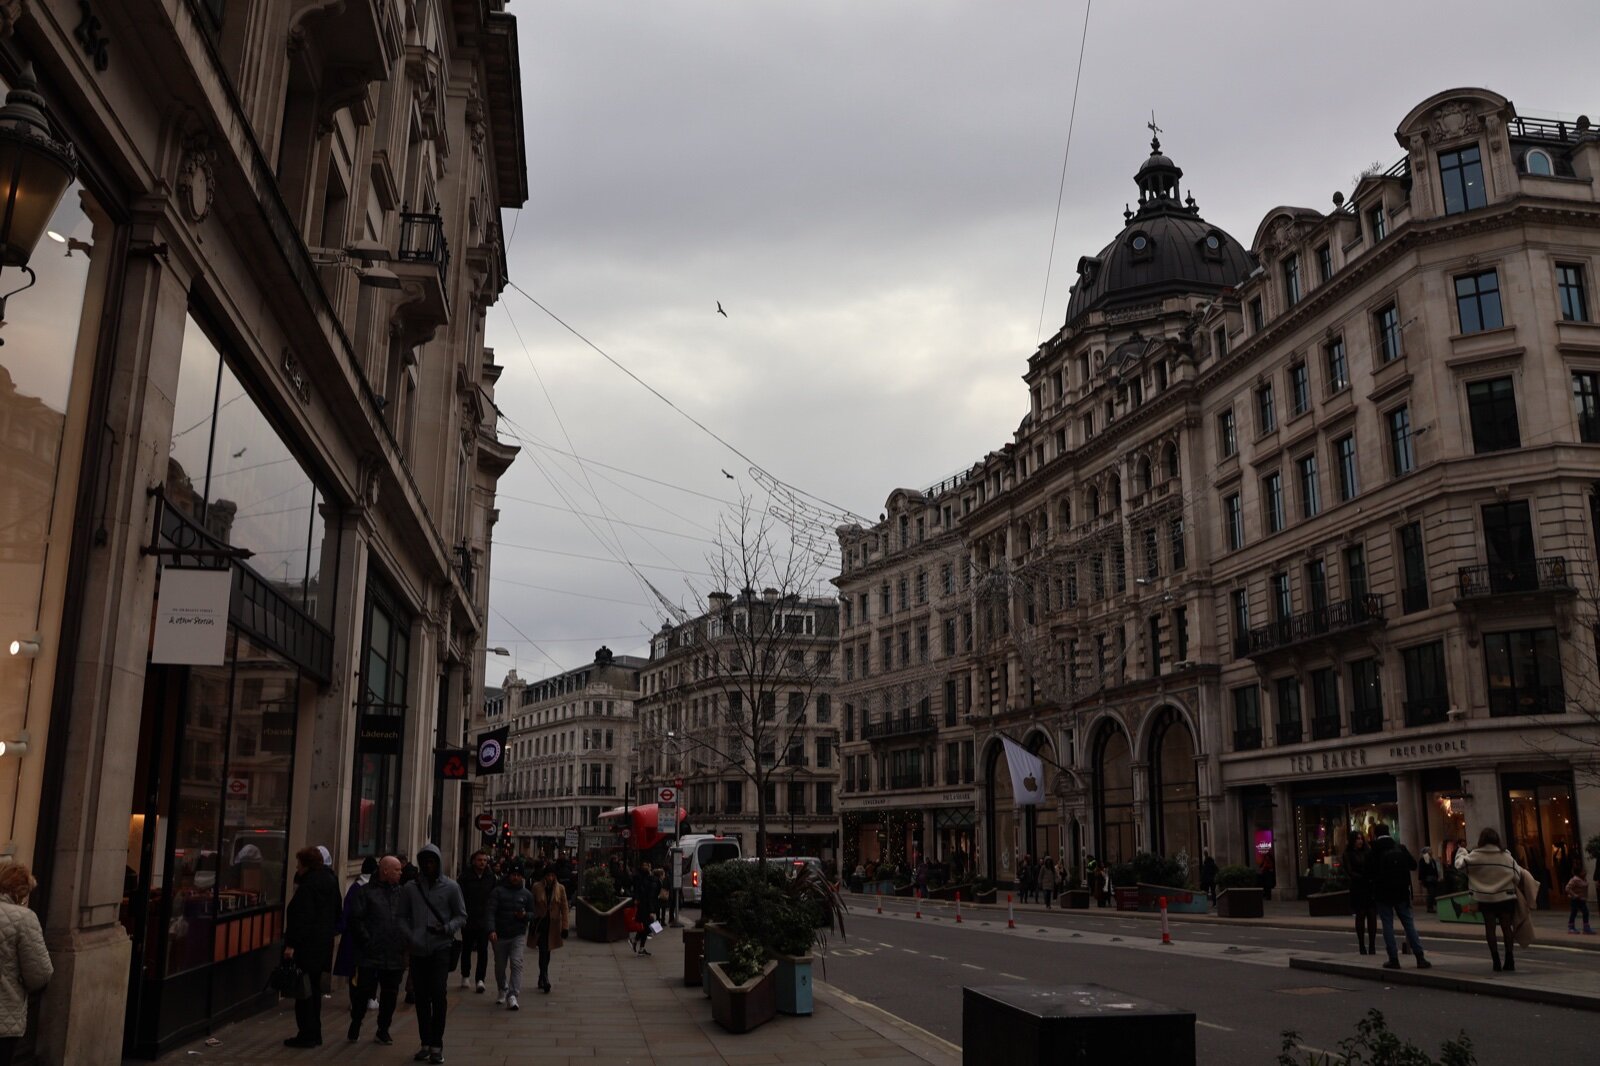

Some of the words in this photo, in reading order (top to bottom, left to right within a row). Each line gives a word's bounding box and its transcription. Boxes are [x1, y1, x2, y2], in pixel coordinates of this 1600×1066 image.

[1389, 746, 1417, 757] FREE
[1419, 739, 1466, 754] PEOPLE
[1289, 756, 1313, 773] TED
[1322, 748, 1368, 770] BAKER
